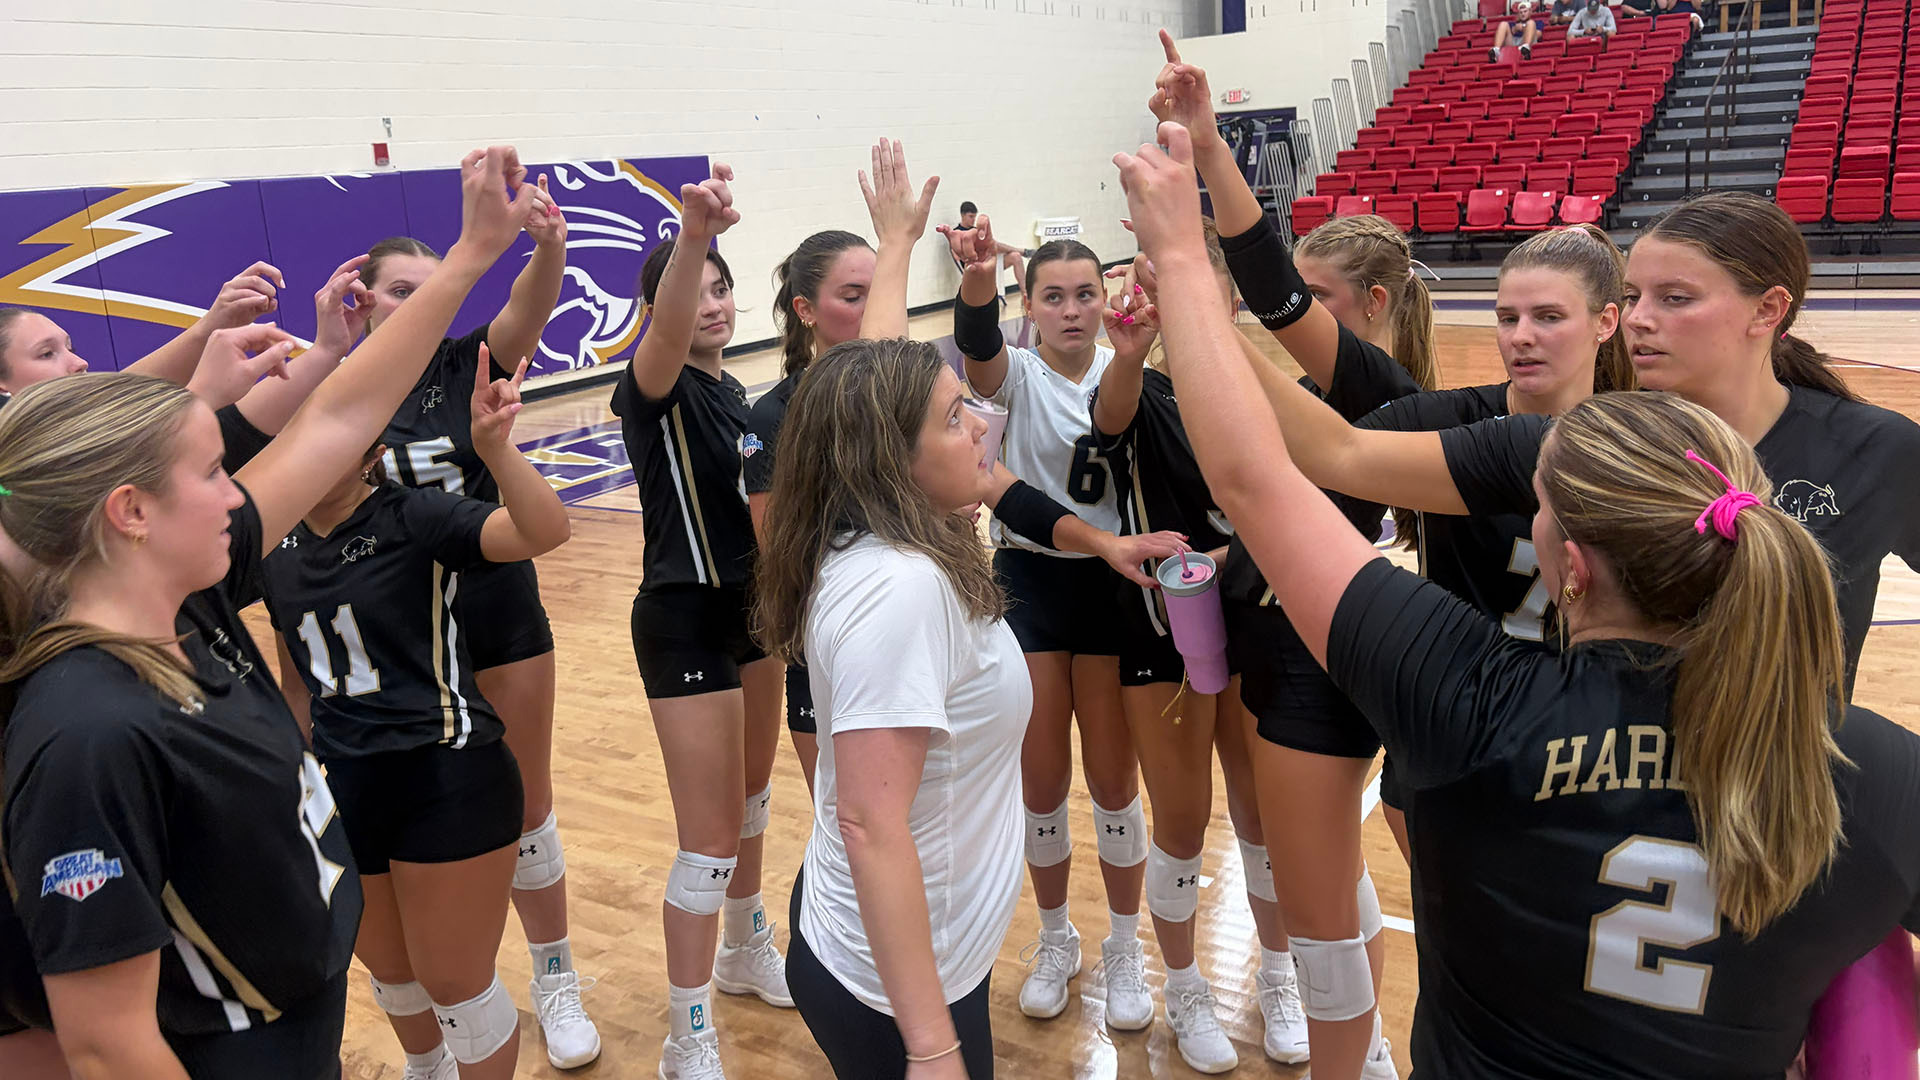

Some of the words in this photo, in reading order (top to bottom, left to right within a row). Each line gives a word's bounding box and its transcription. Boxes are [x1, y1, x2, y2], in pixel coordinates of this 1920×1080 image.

[1228, 90, 1242, 102] EXIT
[382, 436, 465, 496] 15
[1066, 434, 1110, 506] 6
[1502, 537, 1552, 642] 7
[296, 603, 381, 698] 11
[1583, 833, 1722, 1016] 2
